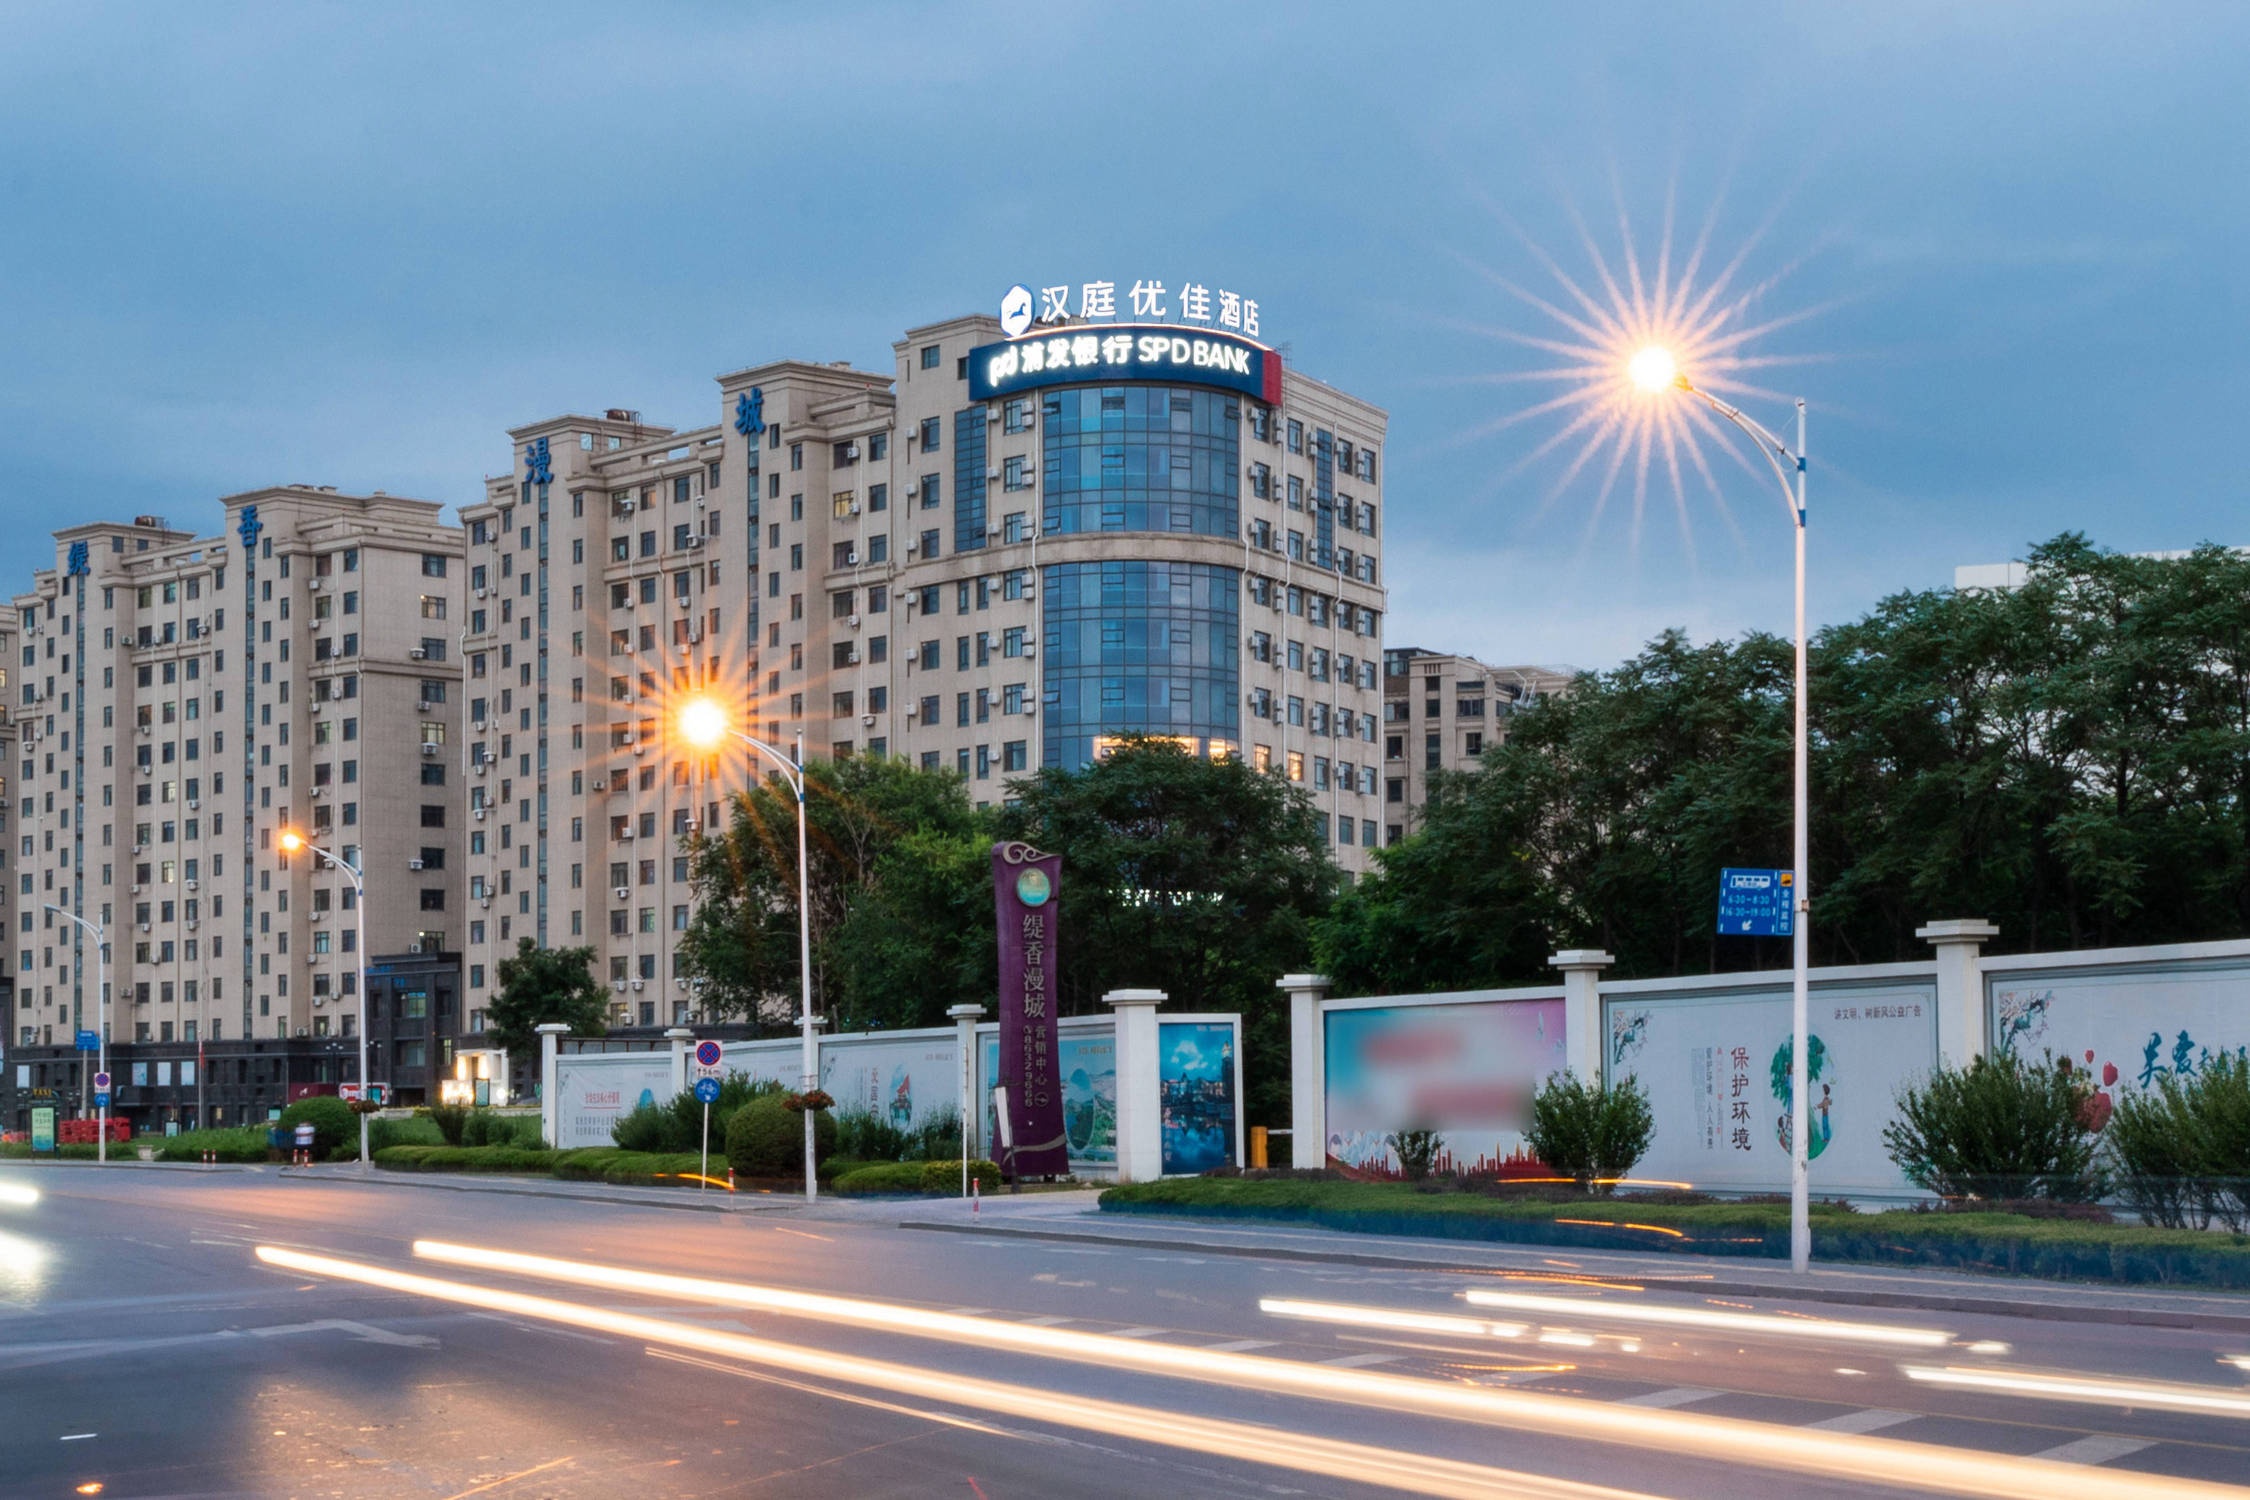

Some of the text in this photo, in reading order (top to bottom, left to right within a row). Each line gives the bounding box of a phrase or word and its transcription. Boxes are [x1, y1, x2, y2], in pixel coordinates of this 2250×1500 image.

[1041, 280, 1260, 337] 汉庭优佳酒店
[1021, 335, 1132, 373] 浦发银行
[735, 387, 766, 434] 城
[525, 436, 554, 484] 漫
[237, 505, 263, 547] 香
[1023, 914, 1046, 1018] 缇香漫城
[1730, 1047, 1752, 1151] 保护环境
